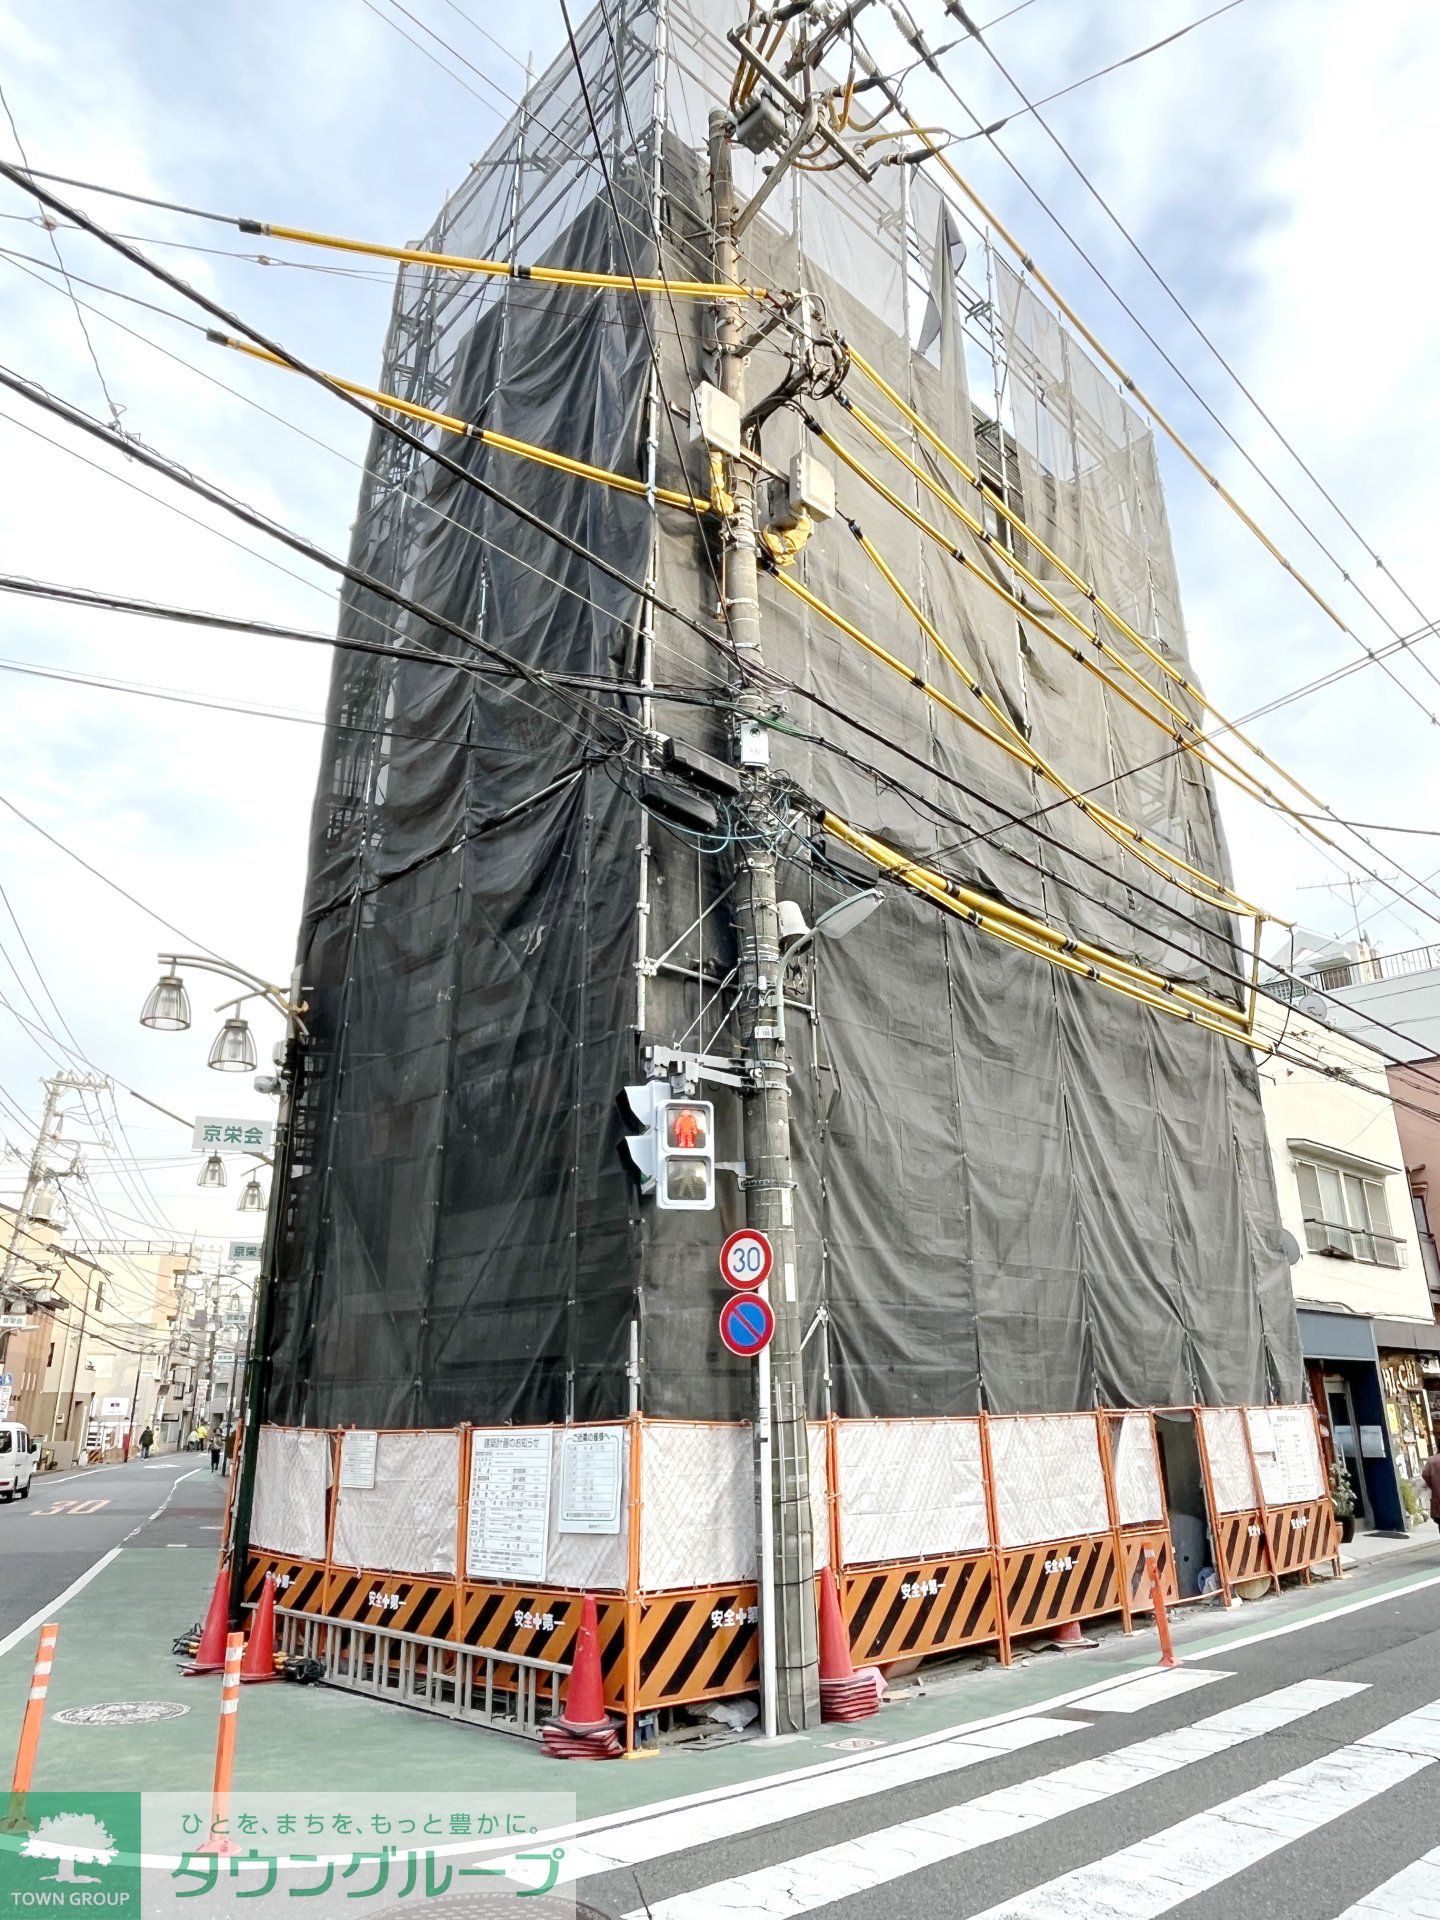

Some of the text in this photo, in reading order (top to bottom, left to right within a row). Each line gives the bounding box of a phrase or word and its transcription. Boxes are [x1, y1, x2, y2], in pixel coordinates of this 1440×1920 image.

[202, 1124, 264, 1145] 京栄会
[733, 1247, 761, 1273] 30
[30, 1499, 112, 1516] 30
